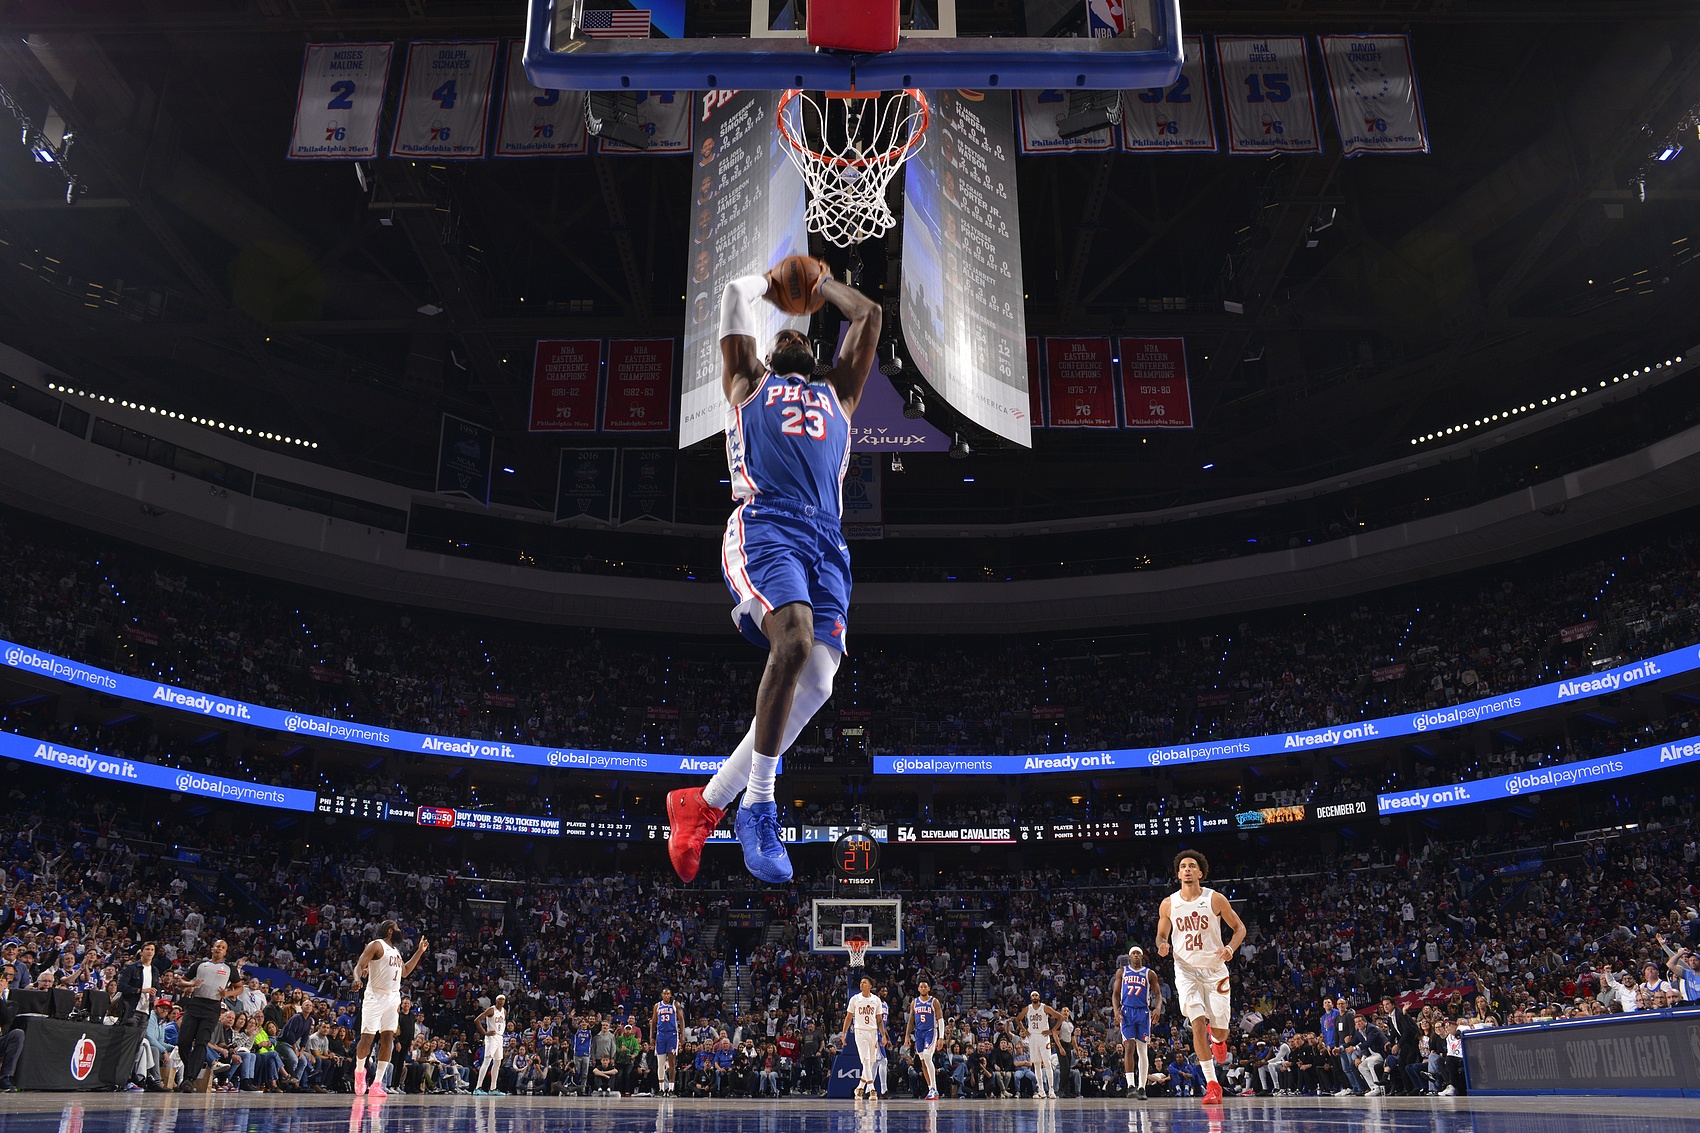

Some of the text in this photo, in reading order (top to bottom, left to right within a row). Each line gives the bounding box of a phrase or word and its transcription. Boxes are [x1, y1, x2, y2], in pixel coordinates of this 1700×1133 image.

[1094, 28, 1112, 38] NBA
[439, 50, 466, 59] DOLPH
[1253, 44, 1270, 53] HAL
[1351, 42, 1376, 52] DAVID
[334, 50, 363, 60] MOSES
[1249, 53, 1277, 63] GREER
[1348, 52, 1383, 62] ZINKOFF
[329, 60, 364, 70] MALONE
[432, 60, 470, 70] SCHAYES
[328, 80, 356, 110] 2
[432, 80, 457, 110] 4
[1244, 73, 1291, 103] 15
[720, 111, 749, 137] SIMONS
[956, 108, 986, 134] HARDEN
[1157, 120, 1178, 135] 76
[1262, 119, 1284, 134] 76
[1365, 118, 1387, 133] 76
[326, 126, 345, 142] 76
[430, 126, 450, 142] 76
[533, 123, 554, 138] 76
[506, 142, 556, 152] Philadelphia
[1133, 138, 1184, 148] Philadelphia
[1239, 138, 1288, 146] Philadelphia
[1344, 136, 1393, 146] Philadelphia
[298, 145, 346, 154] Philadelphia
[402, 144, 452, 154] Philadelphia
[718, 151, 745, 175] EMBIID
[957, 145, 988, 172] WATSON
[717, 193, 741, 214] JAMES
[960, 184, 1002, 218] PORTER JR.
[716, 227, 746, 253] WALKER
[961, 224, 996, 254] PROCTOR
[962, 267, 985, 288] ALLEN
[999, 344, 1011, 358] 12
[552, 355, 583, 363] EASTERN
[625, 355, 656, 363] EASTERN
[545, 364, 589, 372] CONFERENCE
[618, 364, 662, 372] CONFERENCE
[696, 364, 714, 380] 100
[999, 364, 1012, 377] 40
[766, 384, 834, 418] PHILA
[685, 408, 706, 422] BANK
[459, 423, 478, 436] 1985
[782, 406, 826, 441] 23
[858, 434, 926, 446] Xfinity
[5, 646, 117, 689] globalpayments
[1557, 660, 1661, 698] Already on it.
[153, 686, 251, 720] Already on it.
[1412, 697, 1521, 731] globalpayments
[285, 714, 390, 744] globalpayments
[1284, 723, 1379, 748] Already on it.
[422, 737, 515, 758] Already on it.
[1148, 743, 1250, 766] globalpayments
[34, 744, 137, 778] Already on it.
[547, 751, 648, 769] globalpayments
[892, 758, 992, 773] globalpayments
[1024, 752, 1115, 773] Already on it.
[1505, 759, 1623, 794] globalpayments
[176, 772, 285, 802] globalpayments
[1432, 790, 1452, 804] on
[1453, 786, 1470, 801] it.
[442, 814, 451, 822] 50
[1317, 803, 1353, 819] DECEMBER
[1355, 802, 1366, 814] 20
[457, 812, 471, 820] BUY
[473, 814, 492, 822] YOUR
[493, 815, 514, 824] 50/50
[516, 817, 540, 827] TICKETS
[540, 820, 560, 828] NOW!
[870, 830, 887, 839] 2ND
[898, 827, 1010, 841] 54 CLEVELAND CAVALIERS
[848, 840, 871, 851] 5:40
[844, 852, 869, 870] 21
[1185, 934, 1203, 950] 24
[393, 971, 398, 982] 1
[1124, 975, 1146, 985] PHILA
[1128, 986, 1141, 996] 77
[864, 1016, 870, 1024] 9
[1566, 1040, 1598, 1079] SHOP
[1599, 1038, 1638, 1077] TEAM
[1637, 1035, 1675, 1077] GEAR
